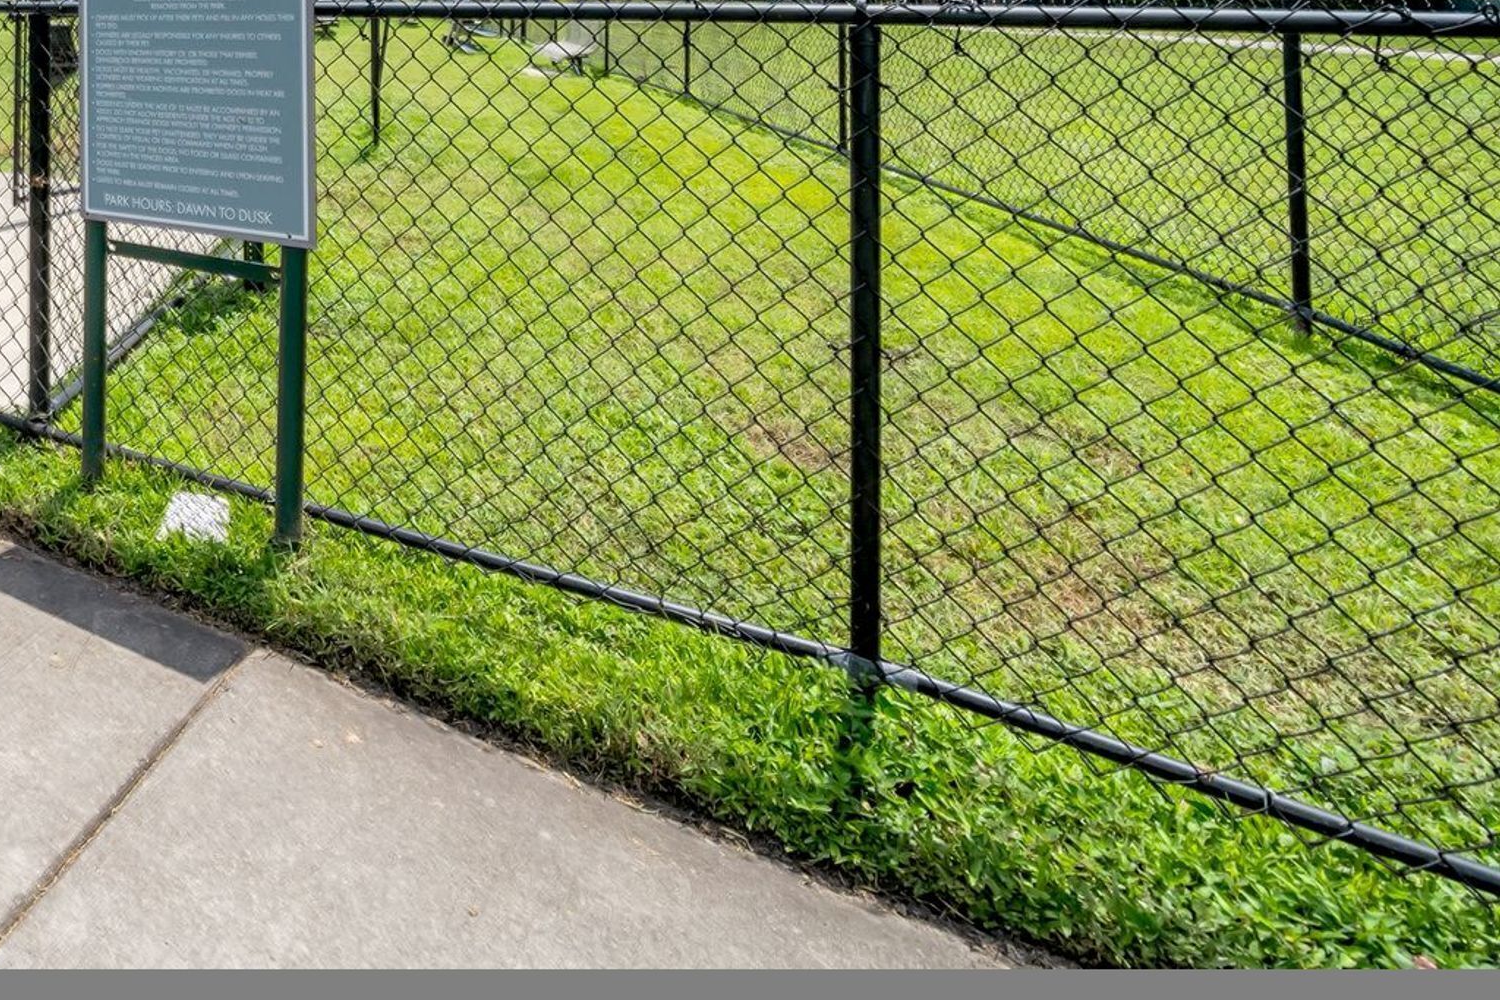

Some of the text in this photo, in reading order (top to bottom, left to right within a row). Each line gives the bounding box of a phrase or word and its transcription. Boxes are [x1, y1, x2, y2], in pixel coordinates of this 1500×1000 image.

[103, 193, 129, 207] PARK
[177, 202, 216, 217] DAWN
[219, 206, 236, 220] TO
[238, 209, 273, 225] DUSK
